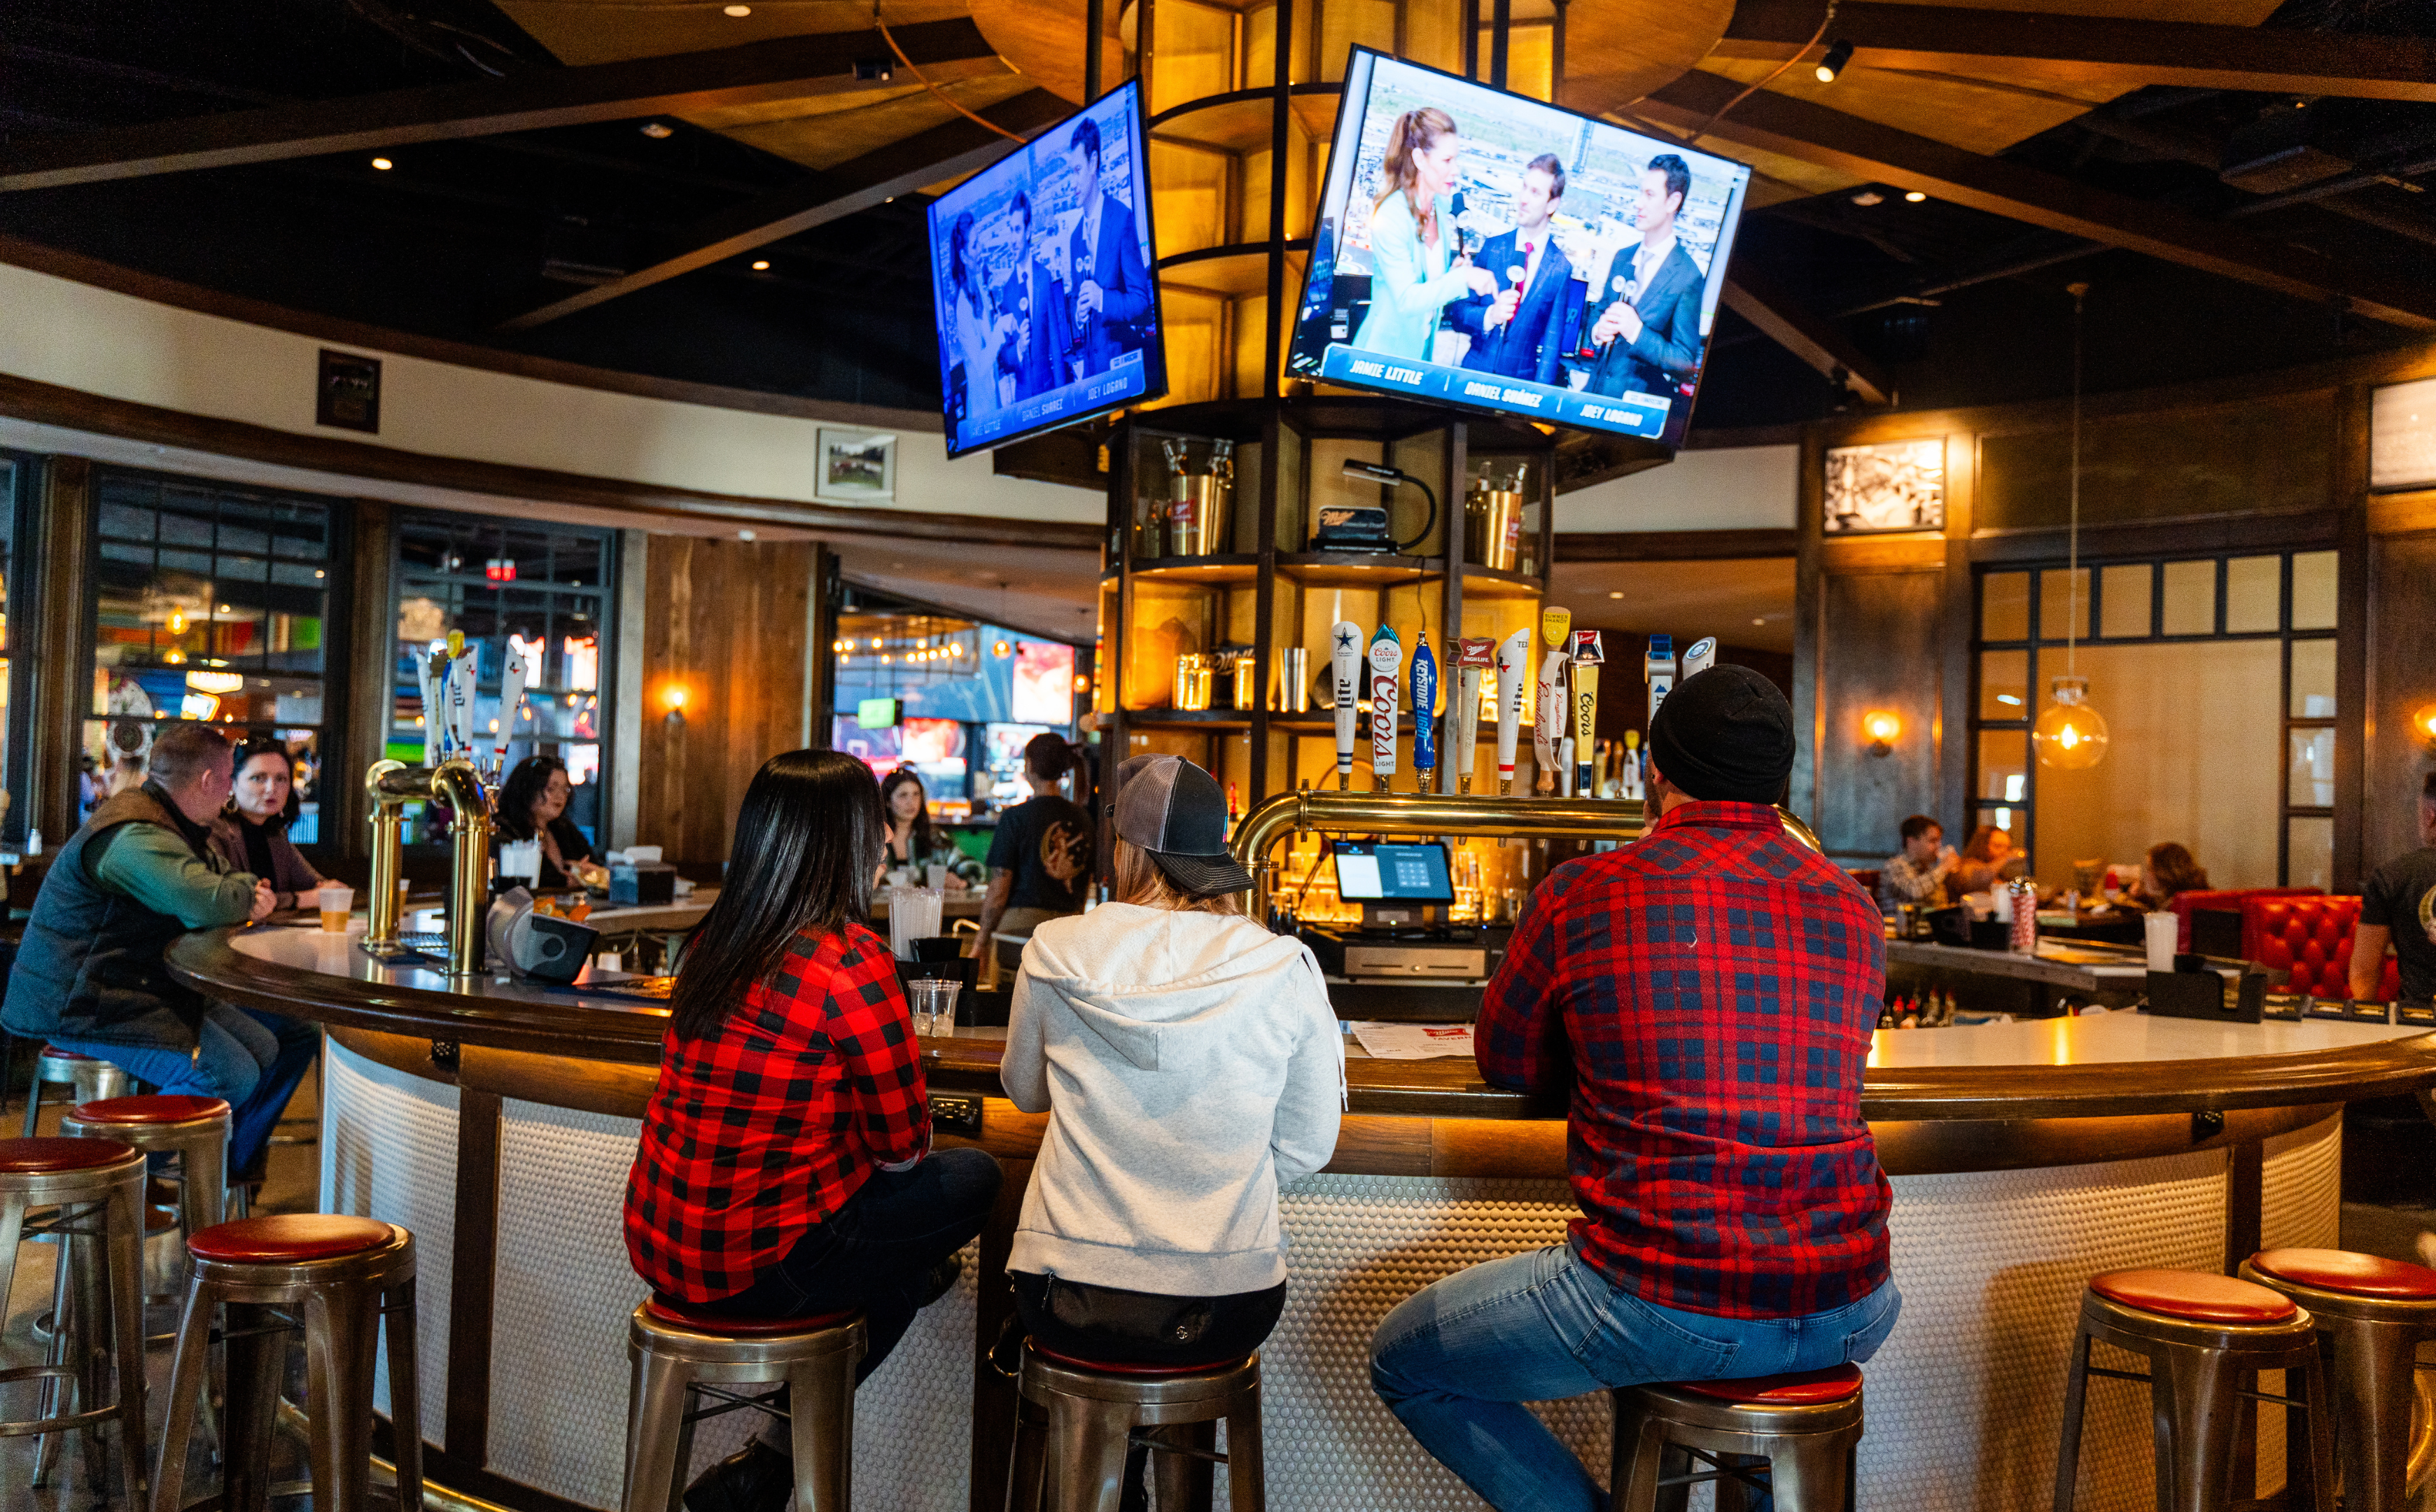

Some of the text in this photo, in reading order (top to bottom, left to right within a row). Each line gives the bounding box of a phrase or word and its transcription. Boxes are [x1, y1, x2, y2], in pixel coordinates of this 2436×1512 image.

[1350, 360, 1424, 386] JAMIE LITTLE
[1464, 381, 1502, 400] DANIEL
[1579, 404, 1605, 419] JOEY
[1374, 648, 1398, 657] Coors
[1466, 645, 1488, 656] Miller
[1337, 678, 1354, 709] Lite
[1415, 658, 1429, 740] KEYSTONE LIGHT
[1373, 674, 1398, 760] Coors
[1580, 692, 1595, 737] Coors
